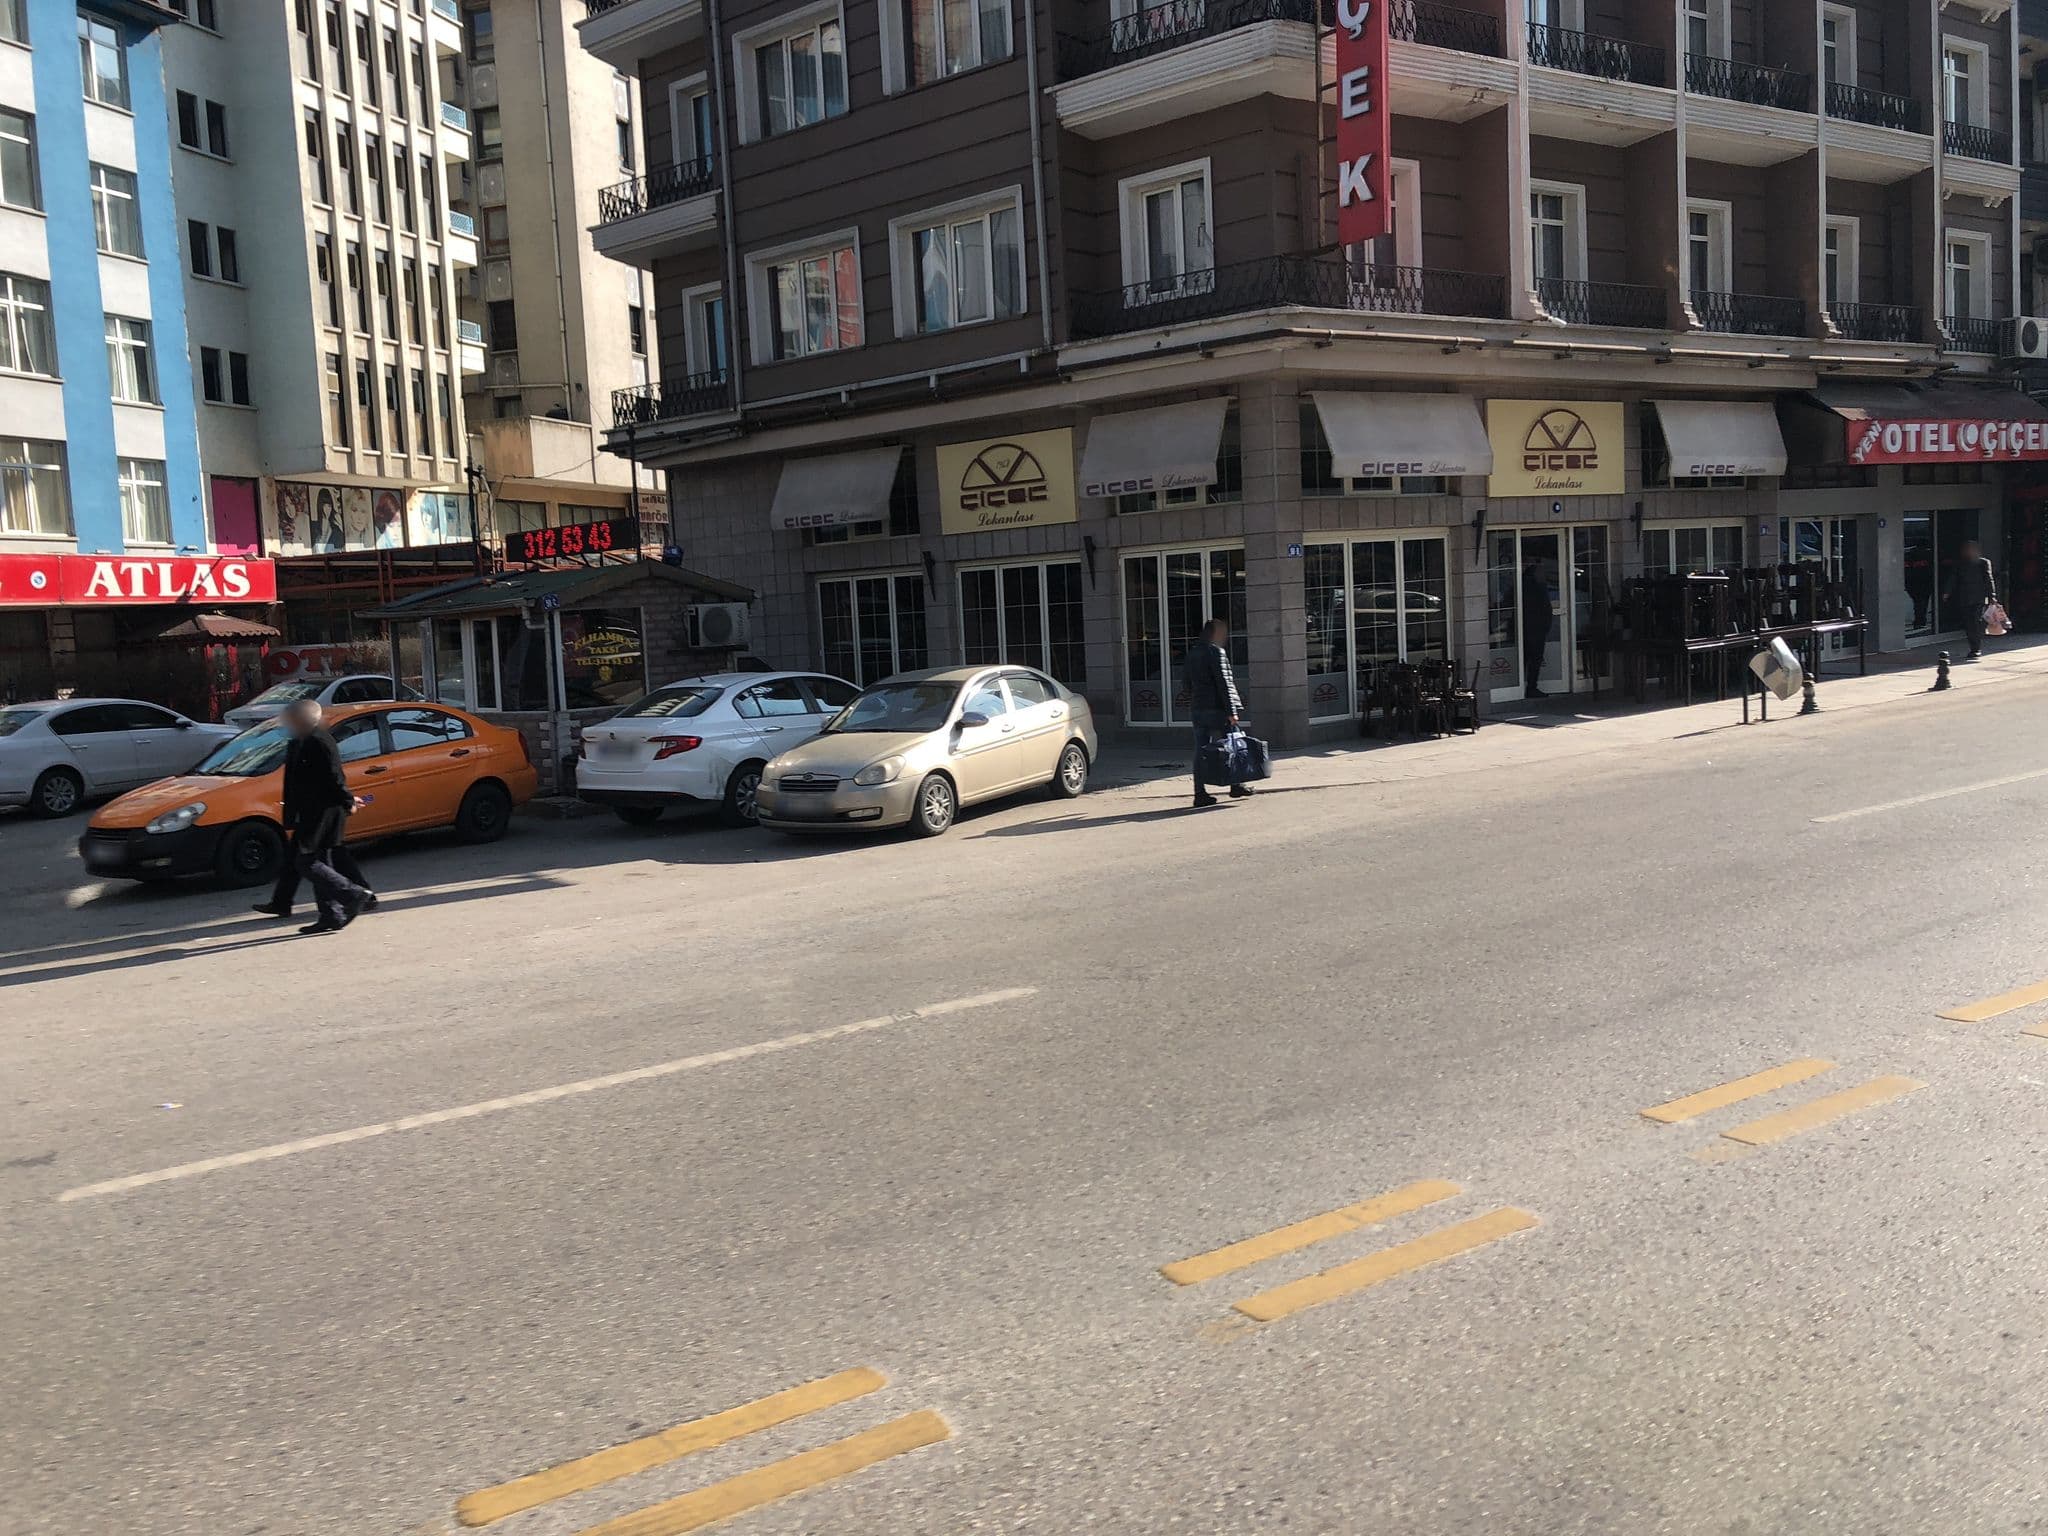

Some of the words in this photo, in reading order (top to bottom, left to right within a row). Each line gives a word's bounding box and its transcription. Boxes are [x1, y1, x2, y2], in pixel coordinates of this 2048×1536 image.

[1883, 423, 1956, 454] OTEL
[524, 529, 557, 559] 312
[588, 521, 612, 551] 43
[84, 561, 251, 598] ATLAS
